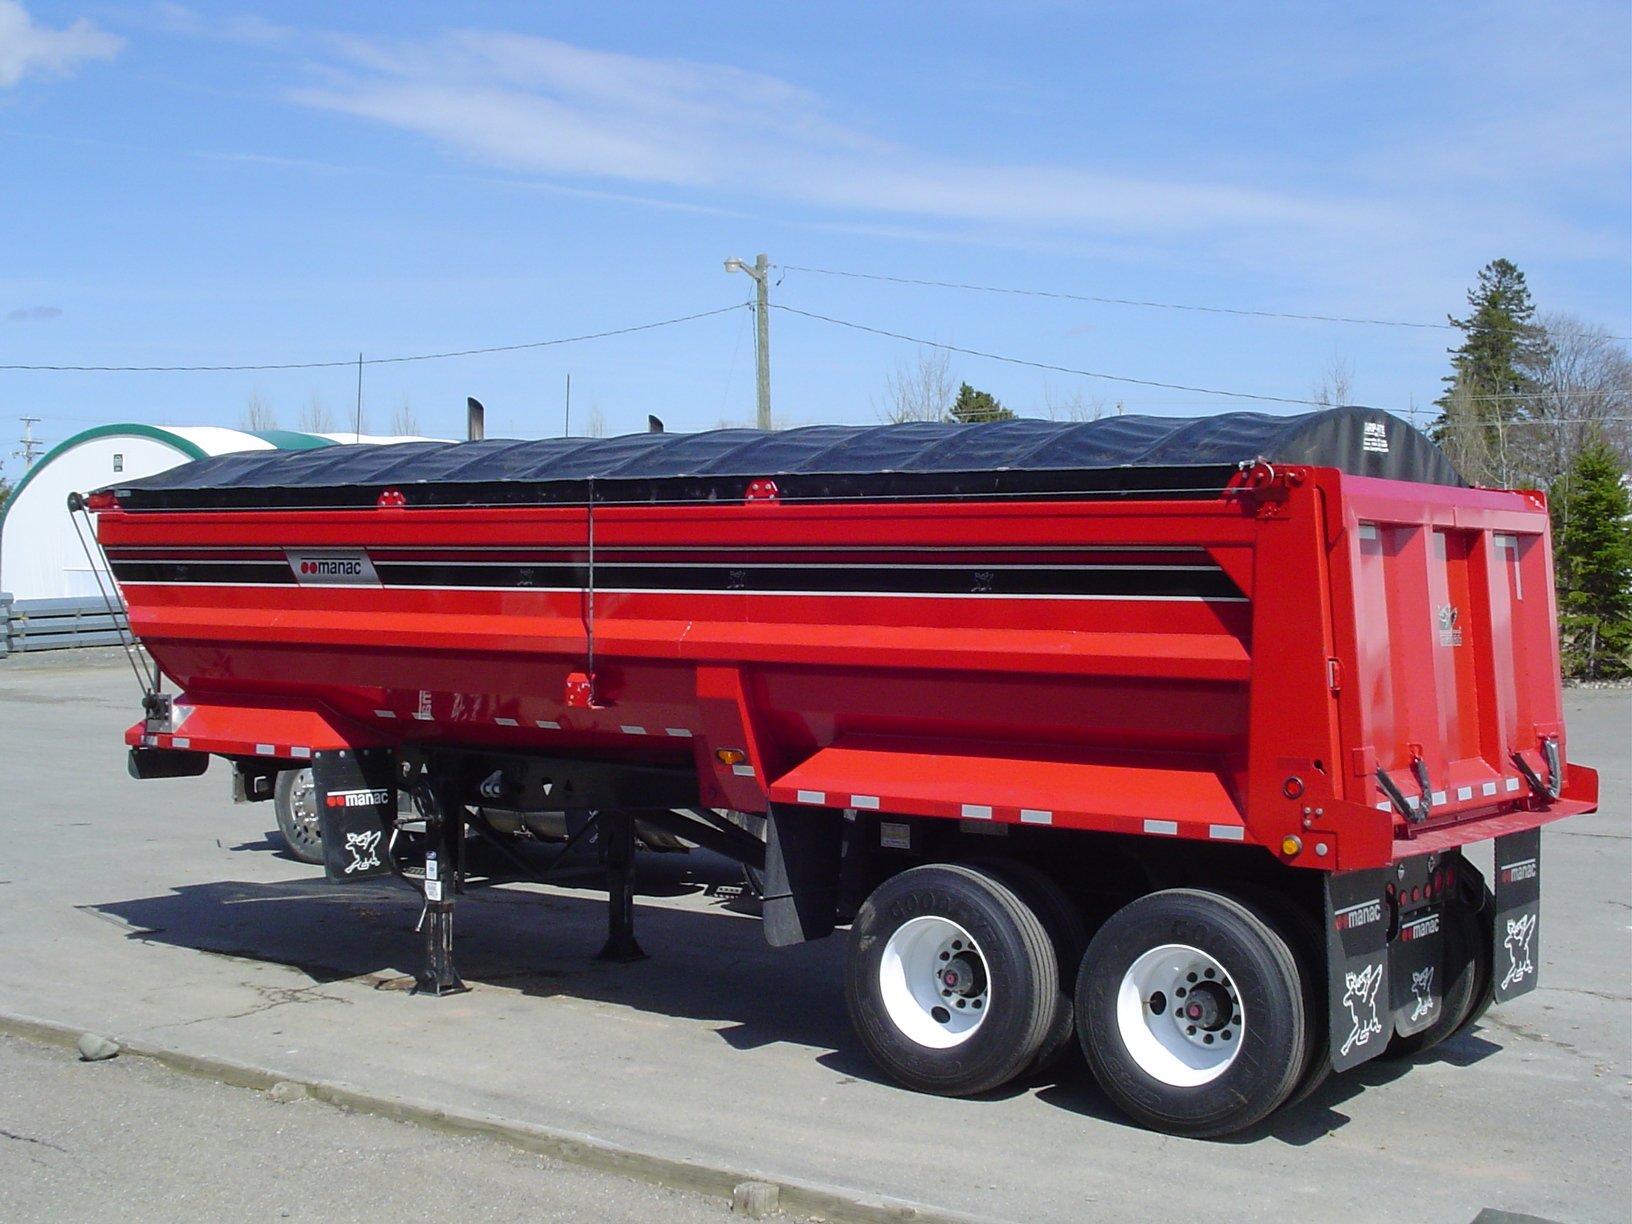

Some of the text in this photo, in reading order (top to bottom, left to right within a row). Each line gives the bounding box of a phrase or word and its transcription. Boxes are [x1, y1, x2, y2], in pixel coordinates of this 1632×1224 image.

[318, 562, 361, 575] manac
[346, 793, 389, 807] manac
[1511, 863, 1536, 882] manac
[1348, 904, 1381, 929] manac
[1413, 918, 1440, 940] manac
